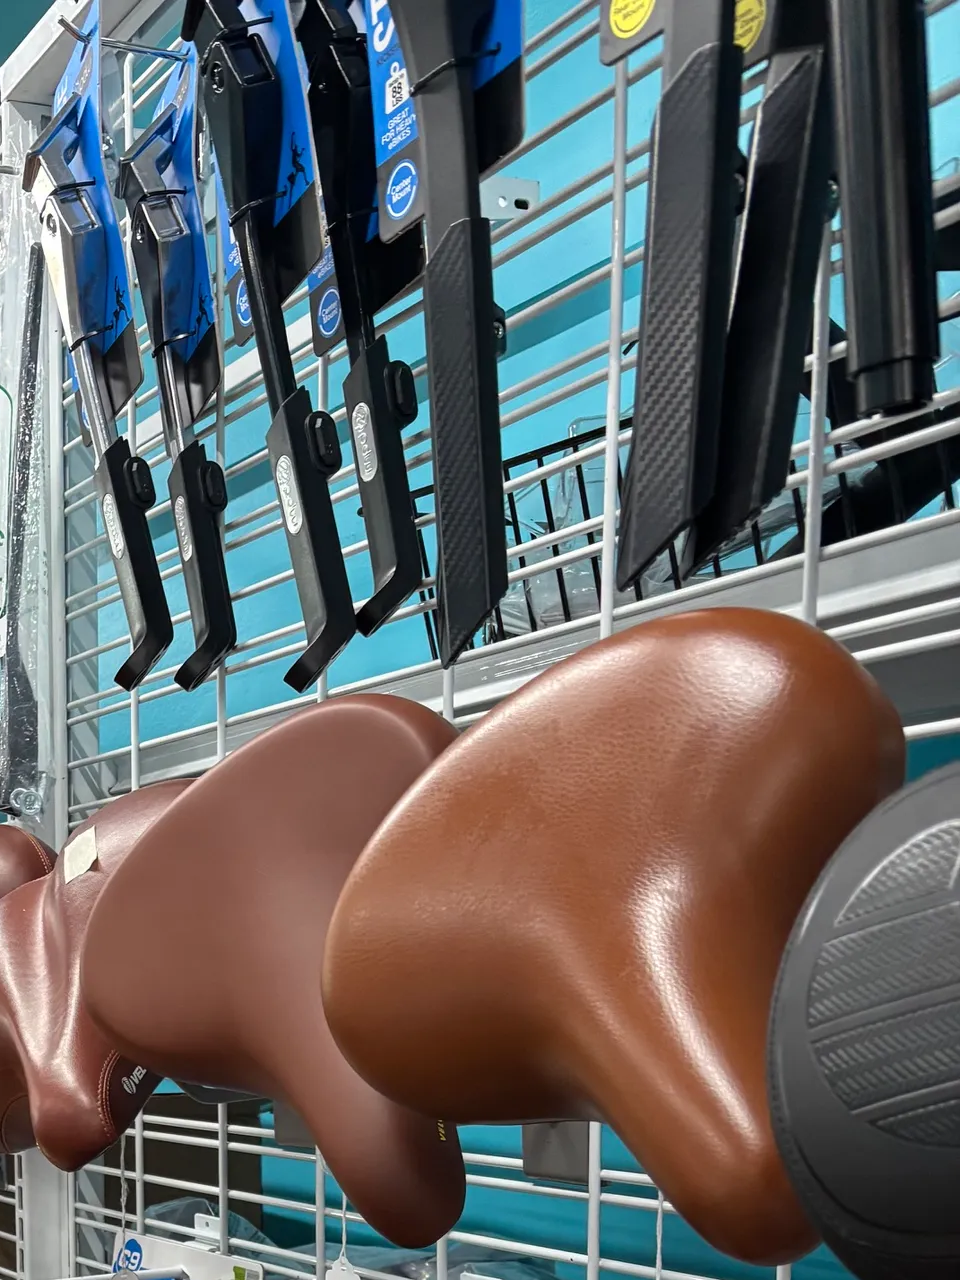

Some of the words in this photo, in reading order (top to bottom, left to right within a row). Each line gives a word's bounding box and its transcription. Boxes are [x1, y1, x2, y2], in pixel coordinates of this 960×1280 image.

[388, 107, 410, 129] GREAT
[381, 129, 395, 146] FOR
[391, 175, 412, 195] Center
[392, 184, 411, 204] Mount
